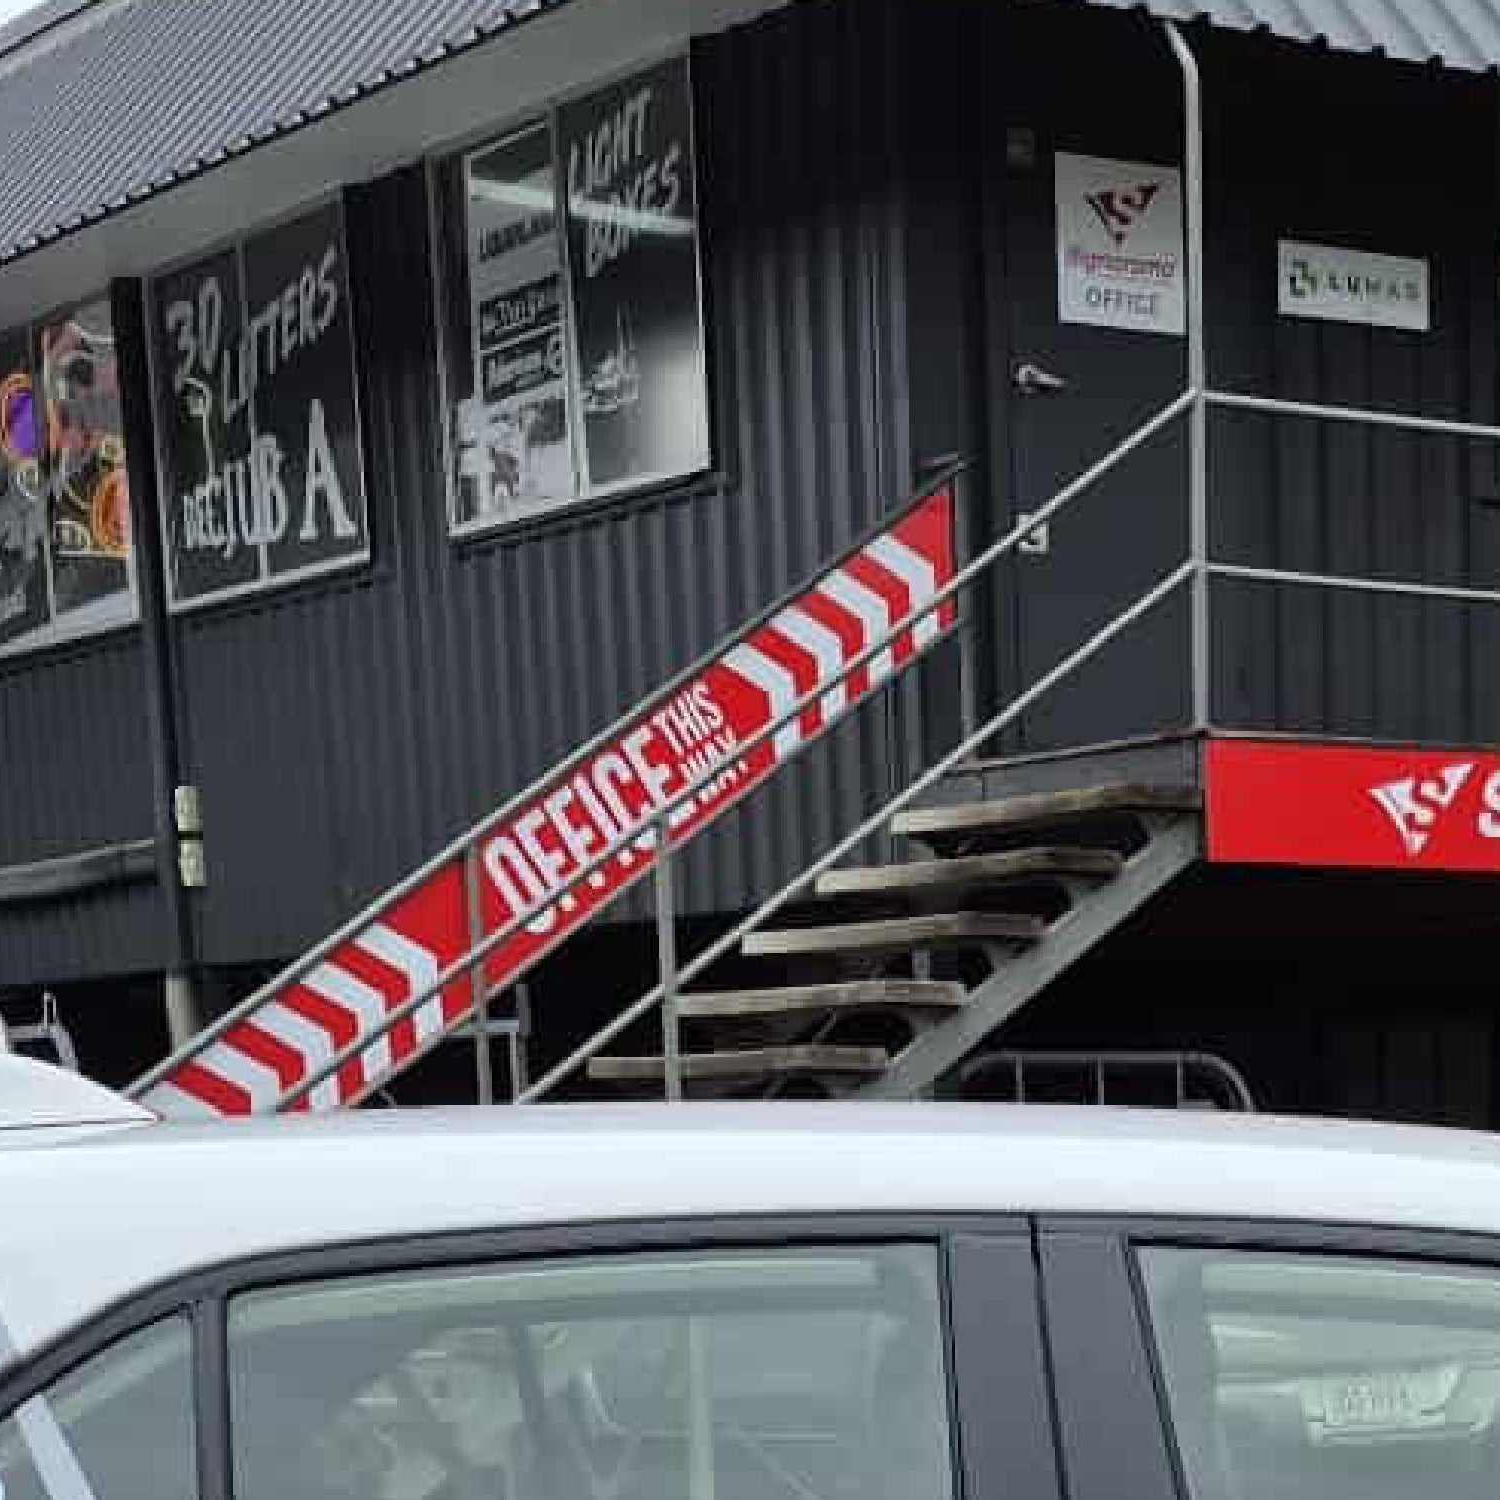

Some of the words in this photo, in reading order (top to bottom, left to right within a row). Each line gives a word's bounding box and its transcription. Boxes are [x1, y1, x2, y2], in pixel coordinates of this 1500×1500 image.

[1085, 286, 1160, 318] OFFICE
[652, 680, 725, 756] THIS
[483, 724, 697, 931] OFFICE
